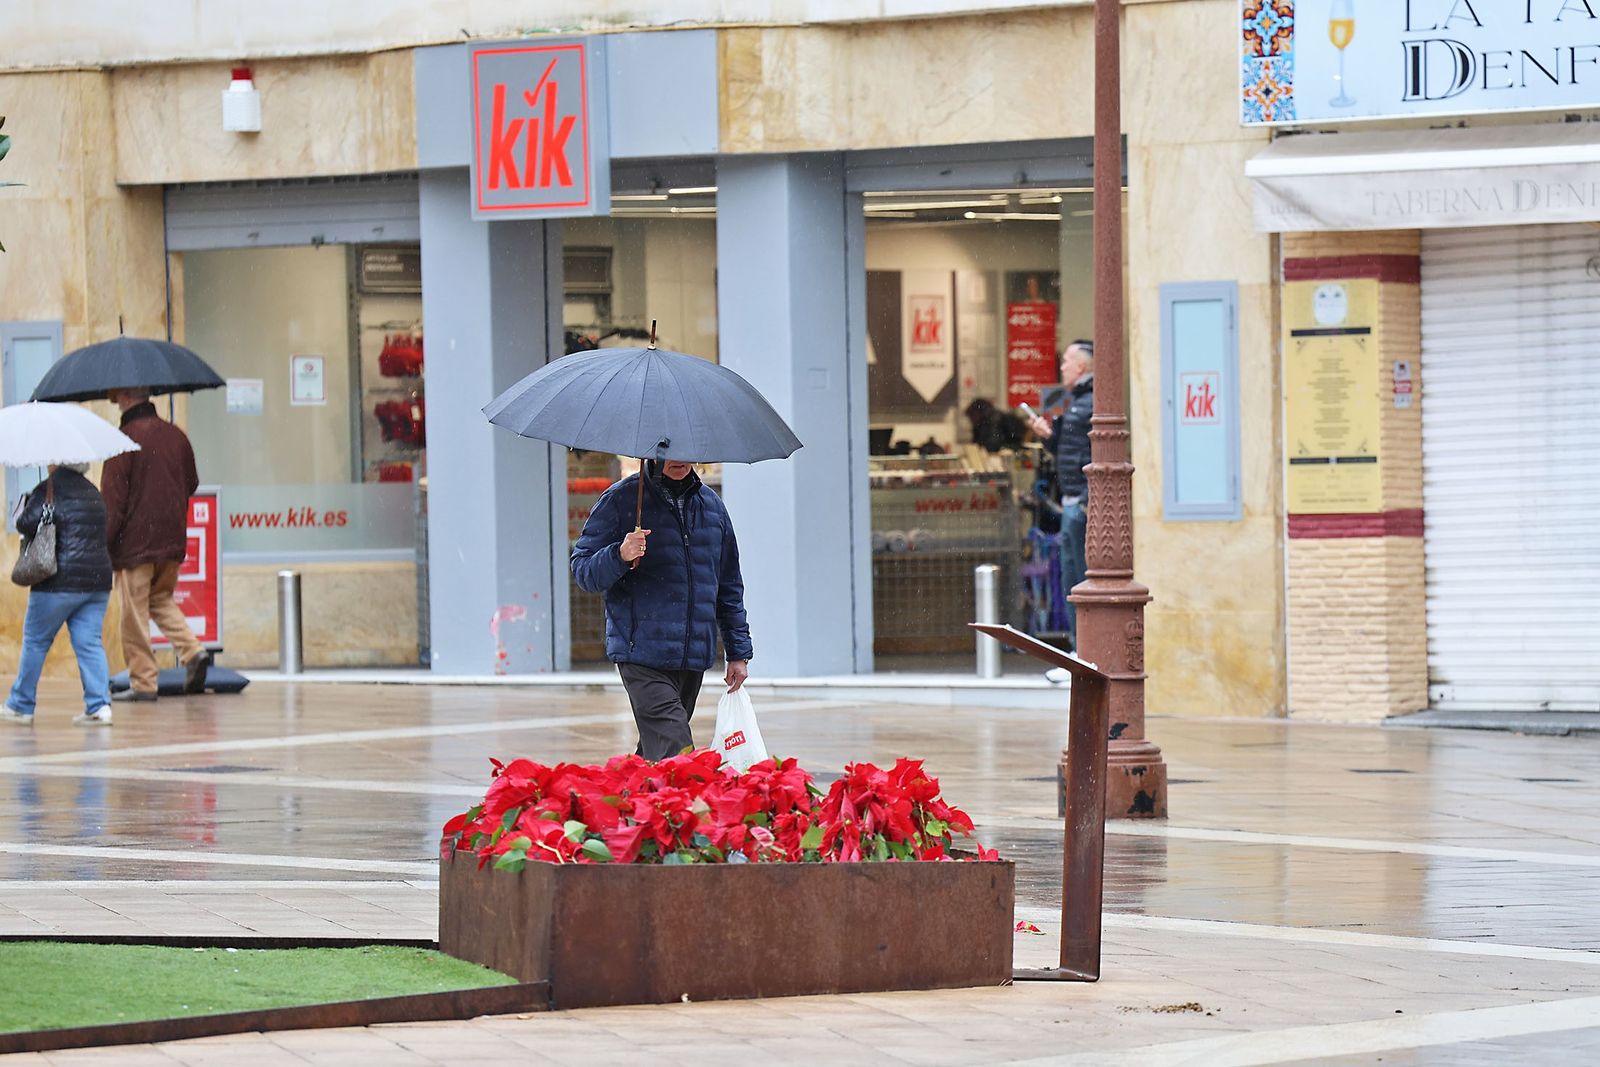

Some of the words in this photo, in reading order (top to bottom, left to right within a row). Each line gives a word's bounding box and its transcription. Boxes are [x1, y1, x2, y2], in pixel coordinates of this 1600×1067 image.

[487, 57, 577, 190] kik
[1365, 186, 1504, 216] TABERNA
[1184, 380, 1216, 417] kik
[229, 506, 348, 529] www.kik.es
